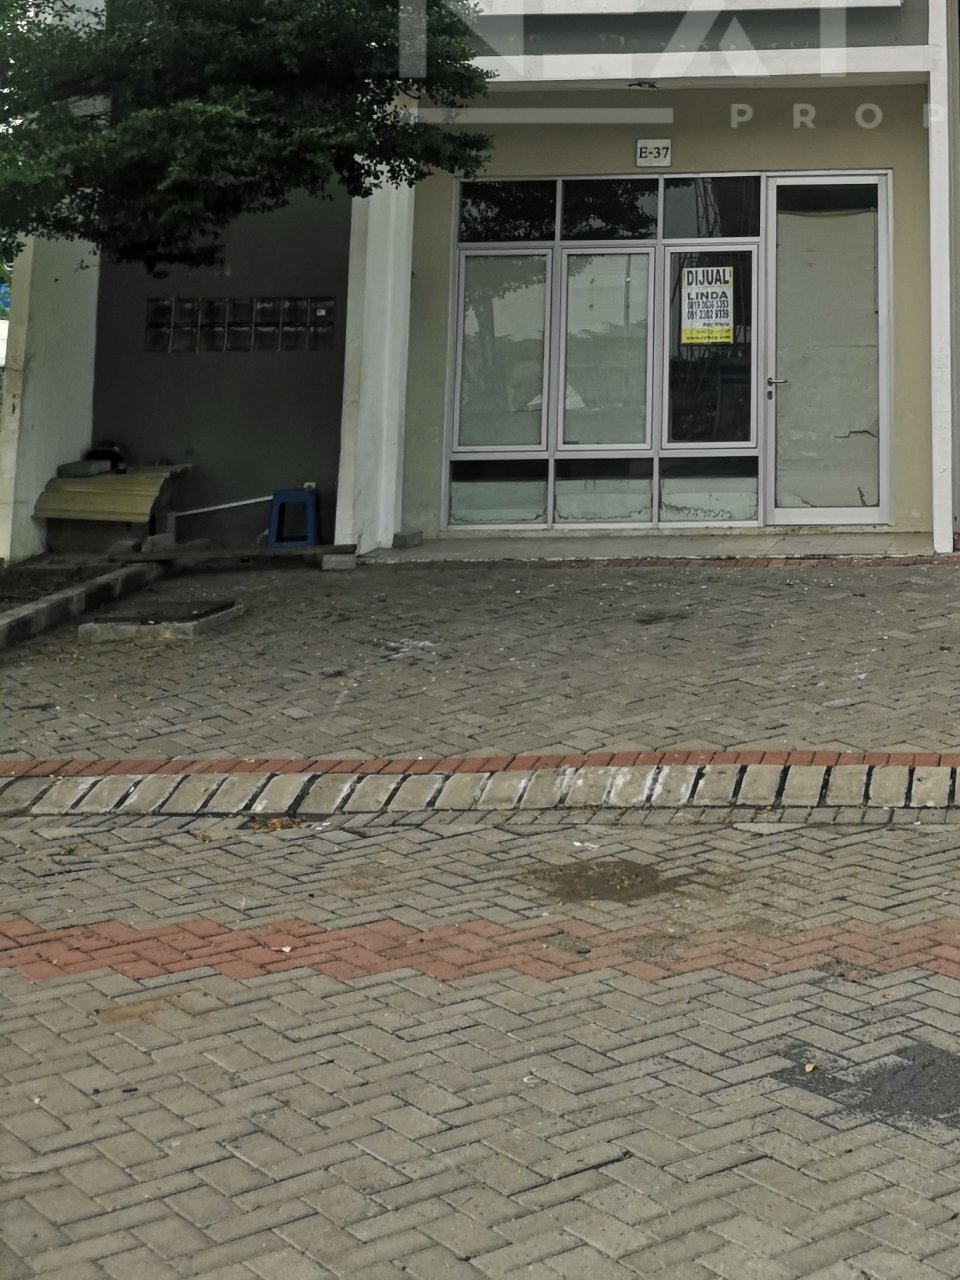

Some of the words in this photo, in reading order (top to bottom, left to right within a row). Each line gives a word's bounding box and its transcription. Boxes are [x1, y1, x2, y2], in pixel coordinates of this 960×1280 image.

[638, 146, 670, 159] E-37
[686, 268, 730, 286] DIJUAL
[687, 291, 728, 300] LINDA
